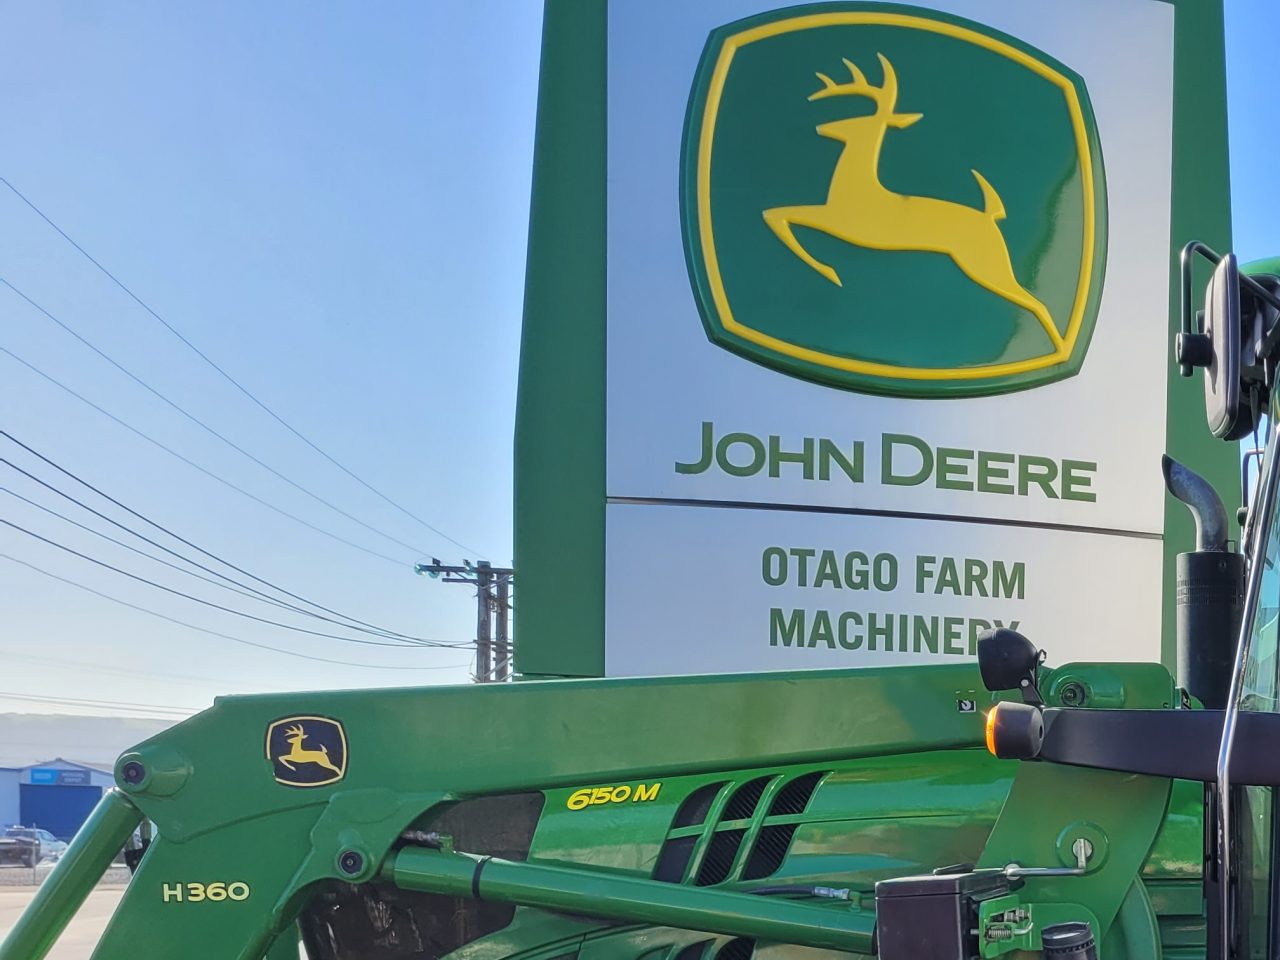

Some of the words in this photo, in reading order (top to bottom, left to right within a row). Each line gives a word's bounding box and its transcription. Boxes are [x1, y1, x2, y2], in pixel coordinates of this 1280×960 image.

[675, 421, 864, 483] JOHN
[881, 432, 1097, 503] DEERE
[761, 546, 898, 592] OTAGO
[915, 555, 1026, 600] FARM
[768, 607, 1021, 656] MACHINER
